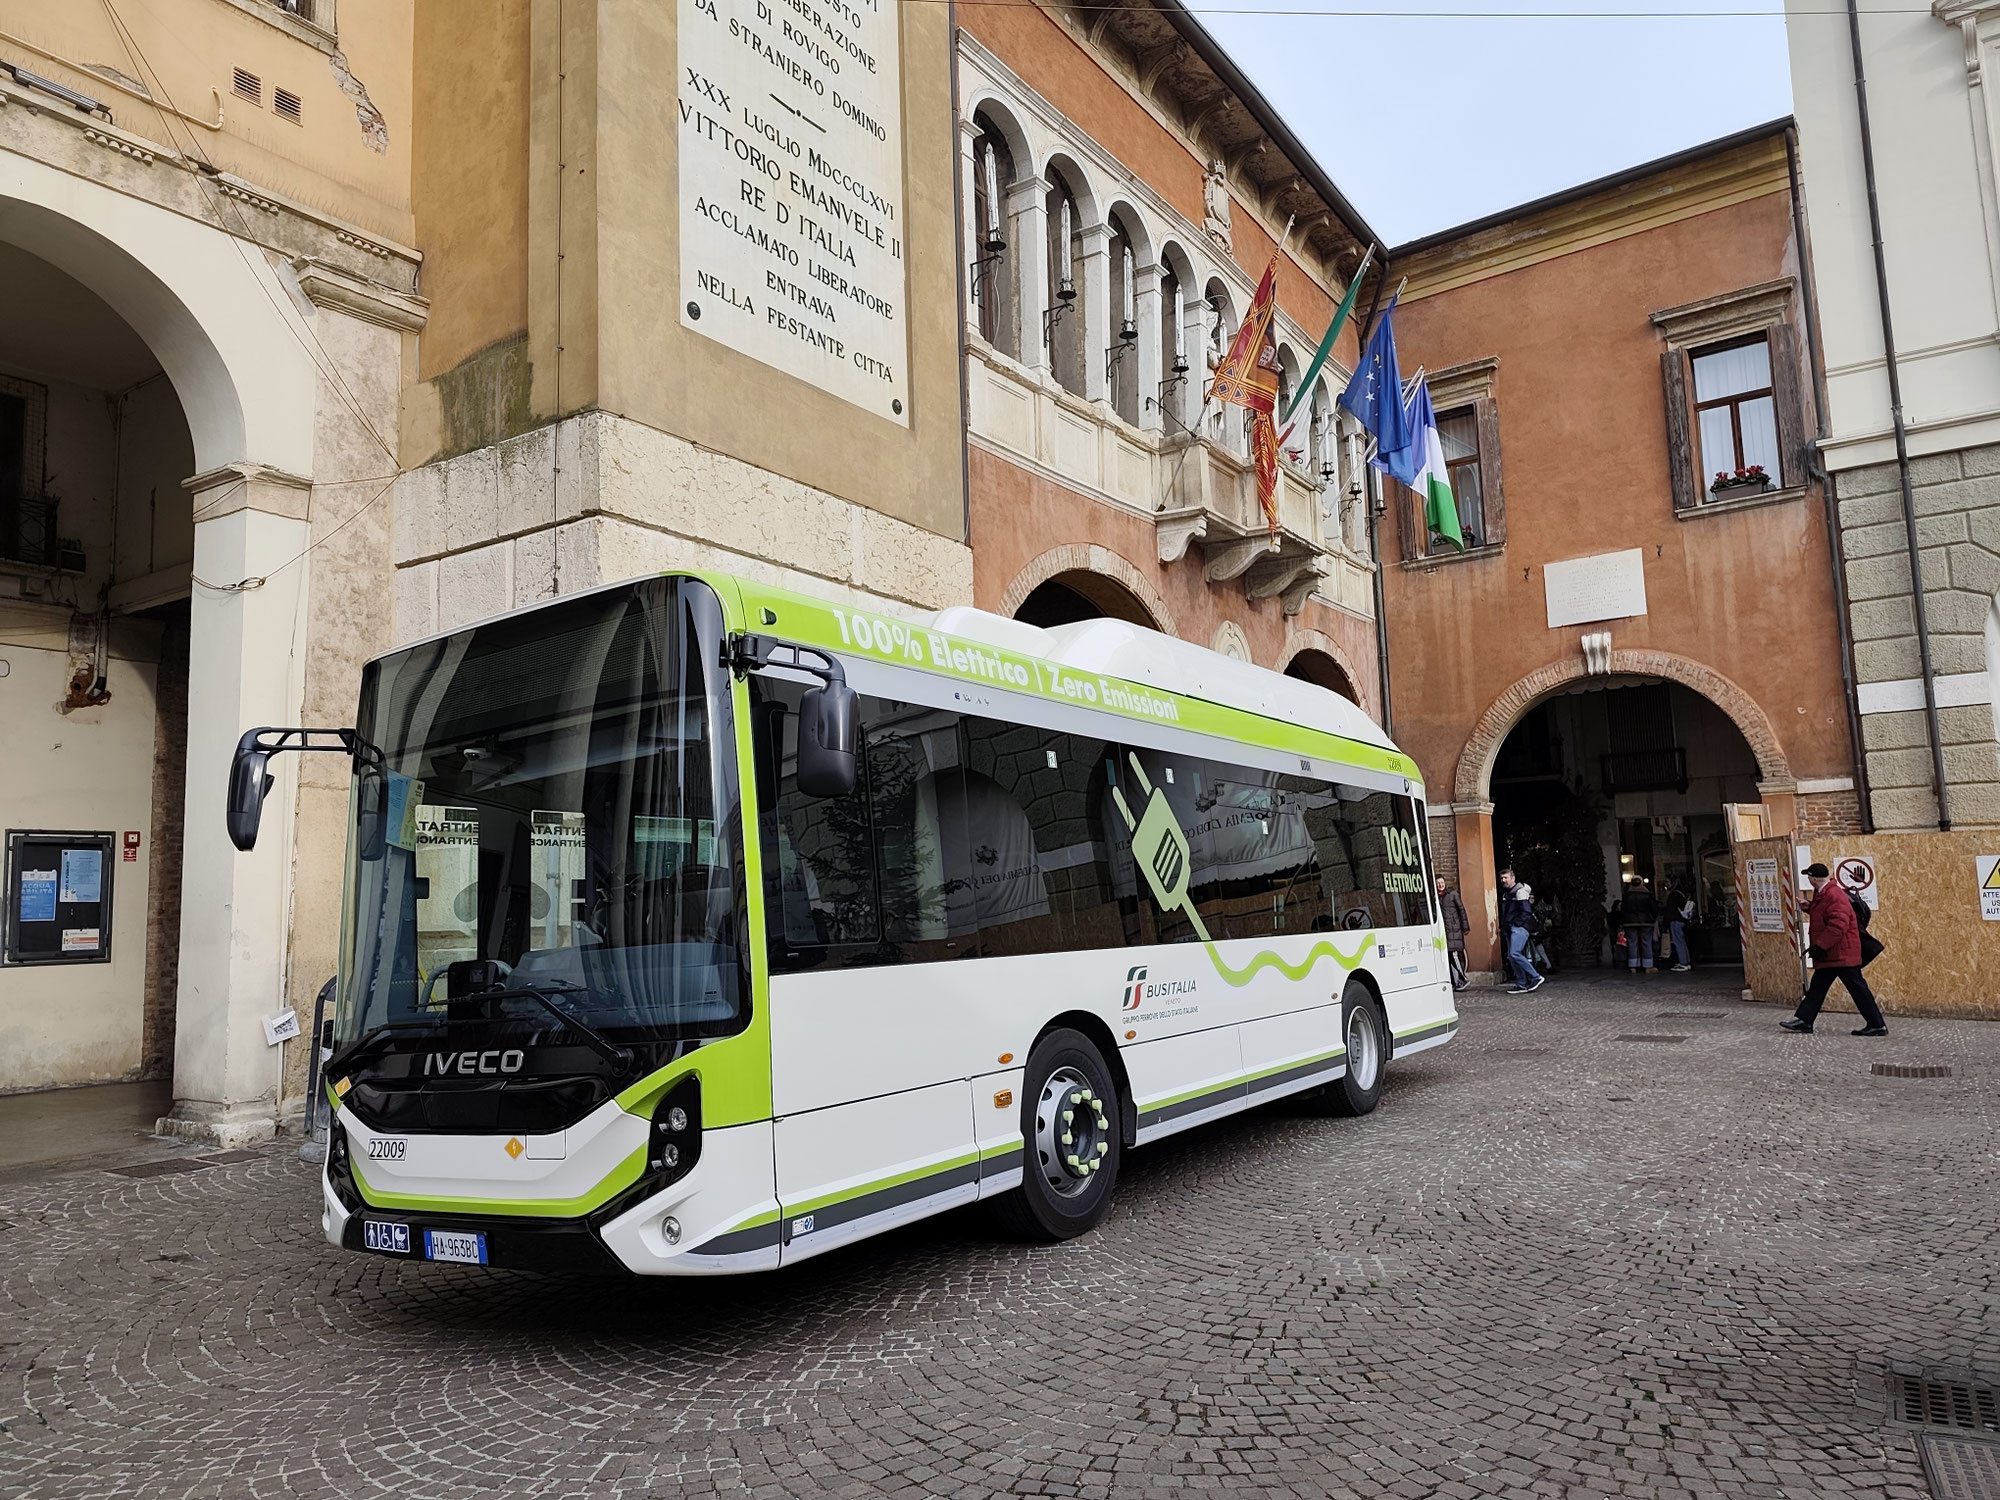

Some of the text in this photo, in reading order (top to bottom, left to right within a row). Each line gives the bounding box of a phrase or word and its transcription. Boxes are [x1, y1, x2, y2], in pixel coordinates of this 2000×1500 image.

[757, 0, 840, 75] DI ROVIGO
[783, 0, 877, 75] BERAZIONE
[824, 0, 861, 29] STO
[729, 17, 824, 96] STRANIERO
[832, 91, 886, 142] DOMINIO
[678, 98, 901, 259] VITTORIO EMANVELE II
[686, 67, 894, 221] XXX LUGLIO MDCCCLXVI
[694, 196, 893, 320] ACCLAMATO LIBERATORE
[740, 179, 766, 213] RE
[799, 214, 857, 268] ITALIA
[697, 269, 755, 315] NELLA
[767, 306, 845, 360] FESTANTE
[766, 270, 836, 323] ENTRAVA
[832, 609, 1180, 721] 100% Elettrico Zero Emissioni
[1383, 872, 1424, 893] ELETTRICO
[1147, 980, 1197, 998] BUSITALIA
[423, 1049, 524, 1076] IVECO
[369, 1140, 405, 1159] 22009
